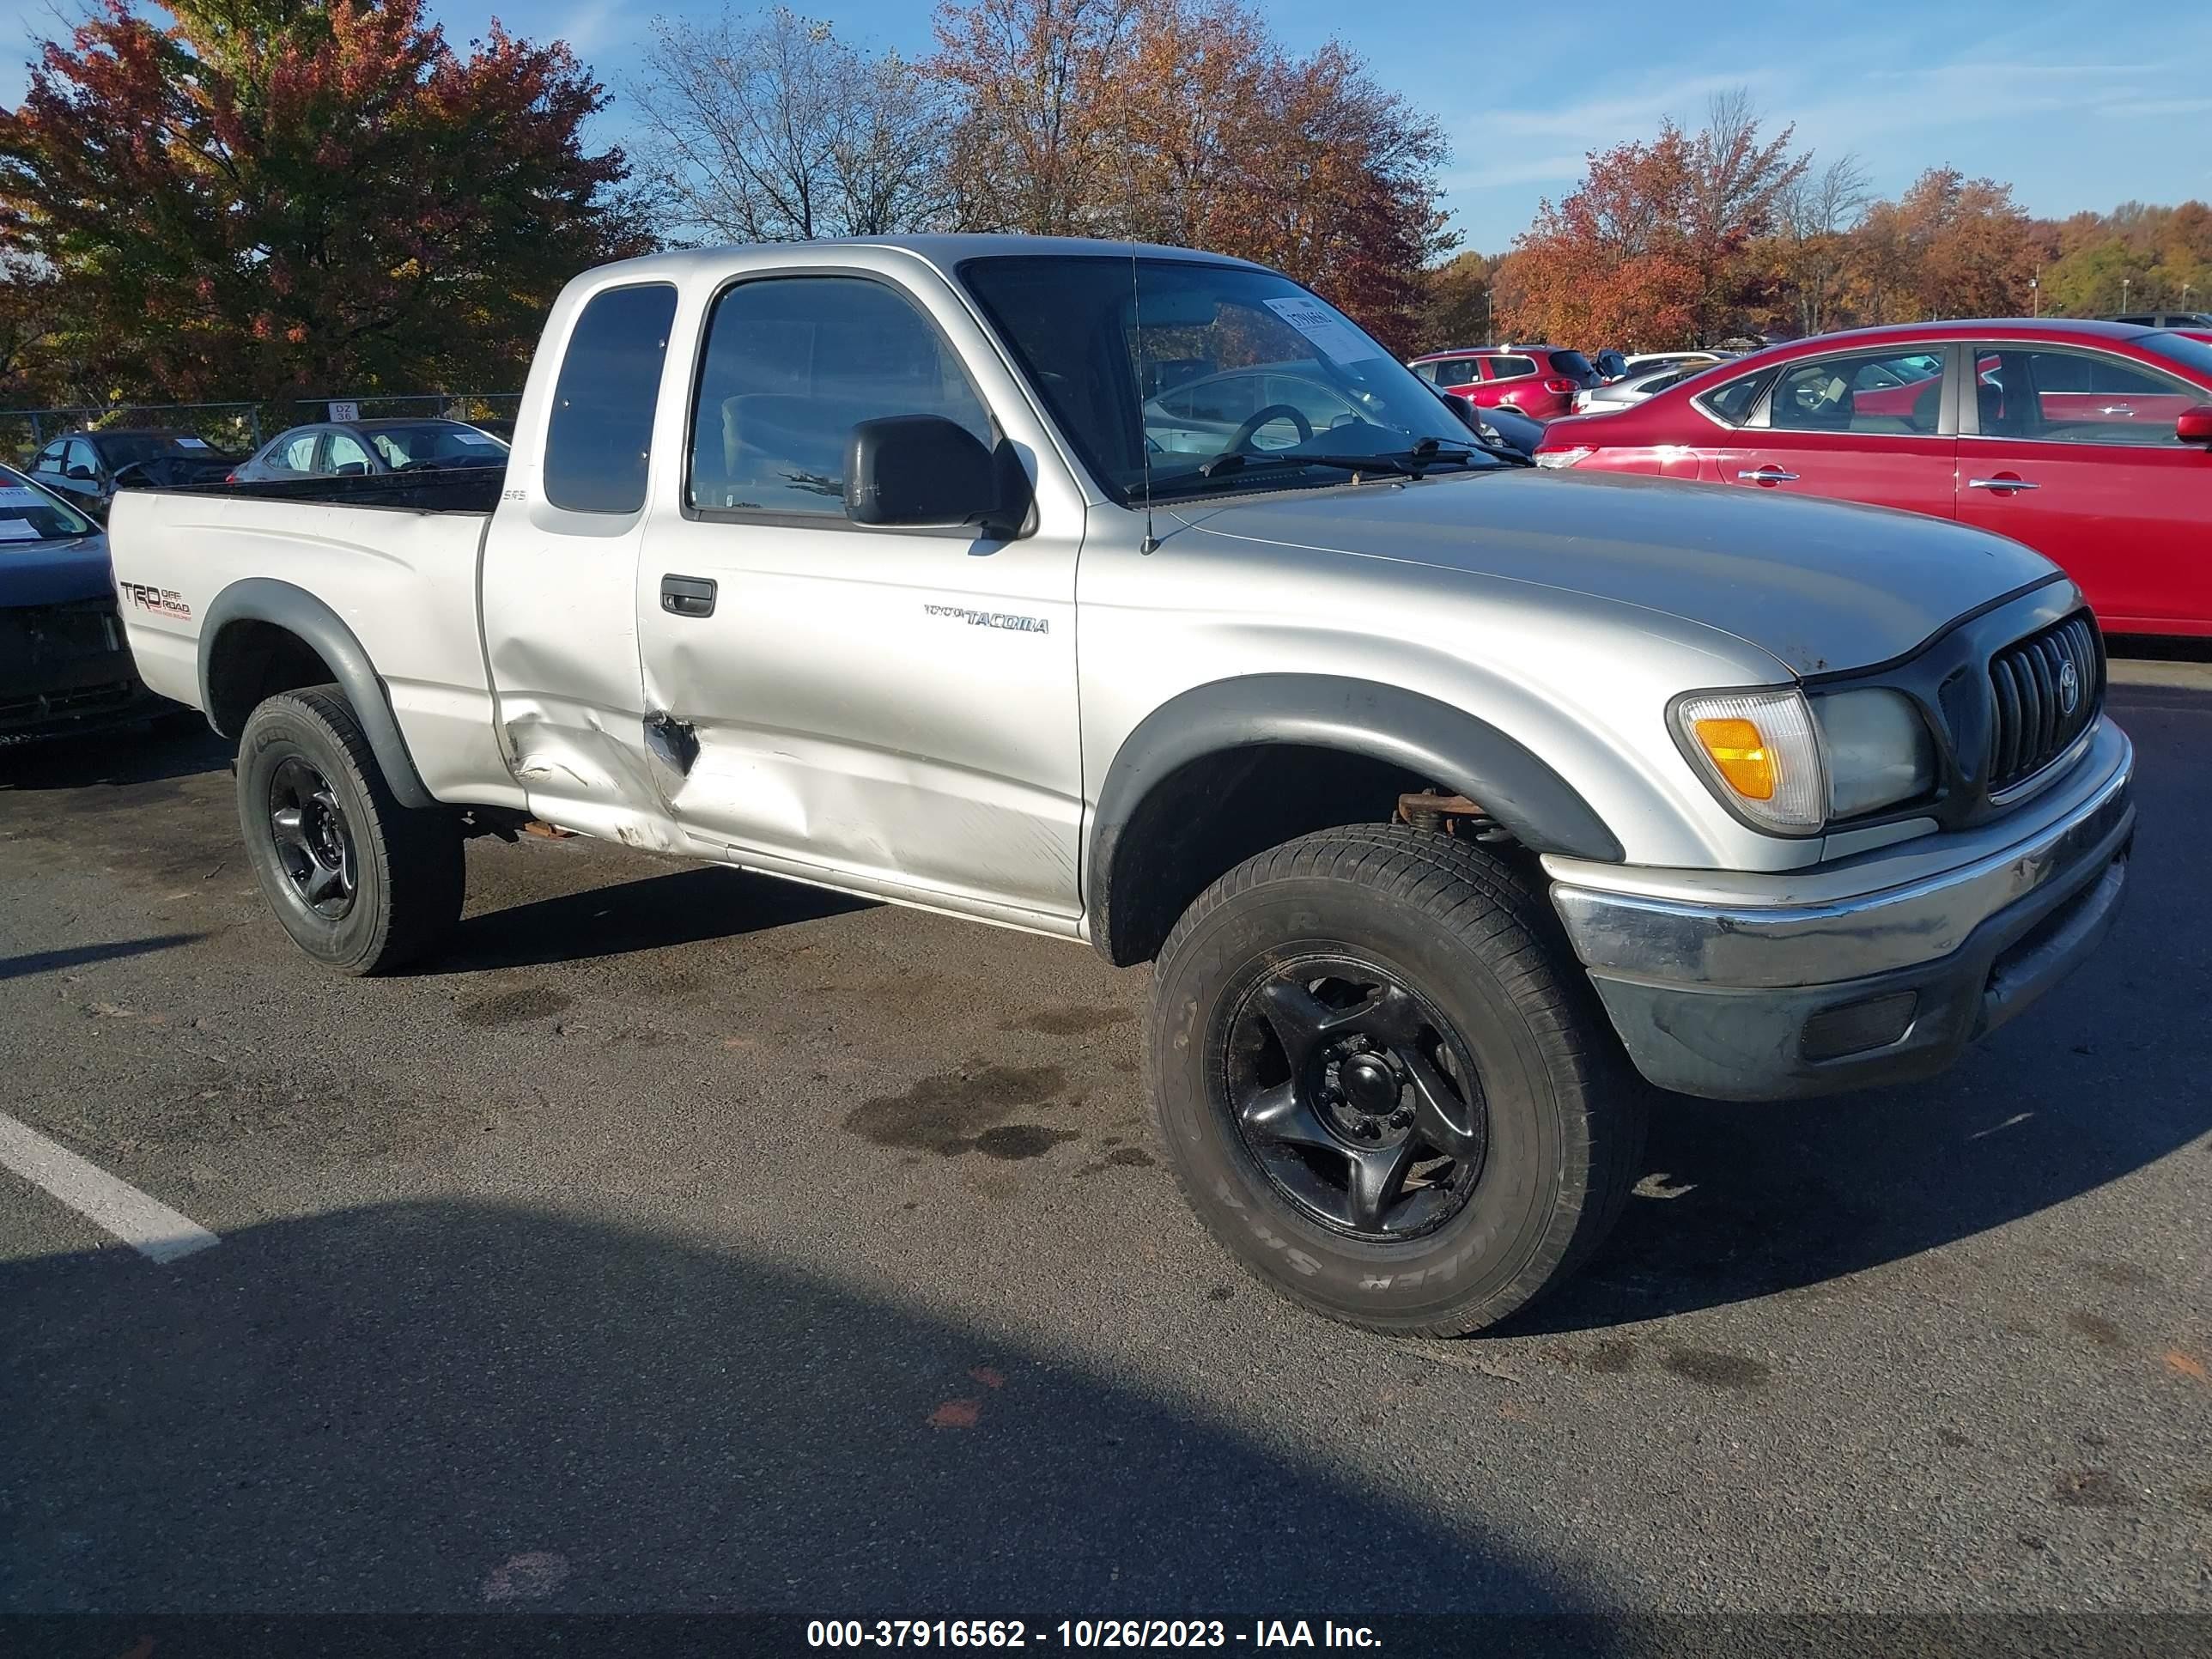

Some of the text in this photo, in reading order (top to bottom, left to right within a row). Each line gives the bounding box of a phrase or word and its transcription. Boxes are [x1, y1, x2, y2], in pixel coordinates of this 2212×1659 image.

[337, 404, 351, 413] DZ
[120, 581, 161, 610] TRD
[161, 589, 182, 600] OFF
[162, 600, 191, 614] ROAD
[964, 610, 1049, 635] TACOMA
